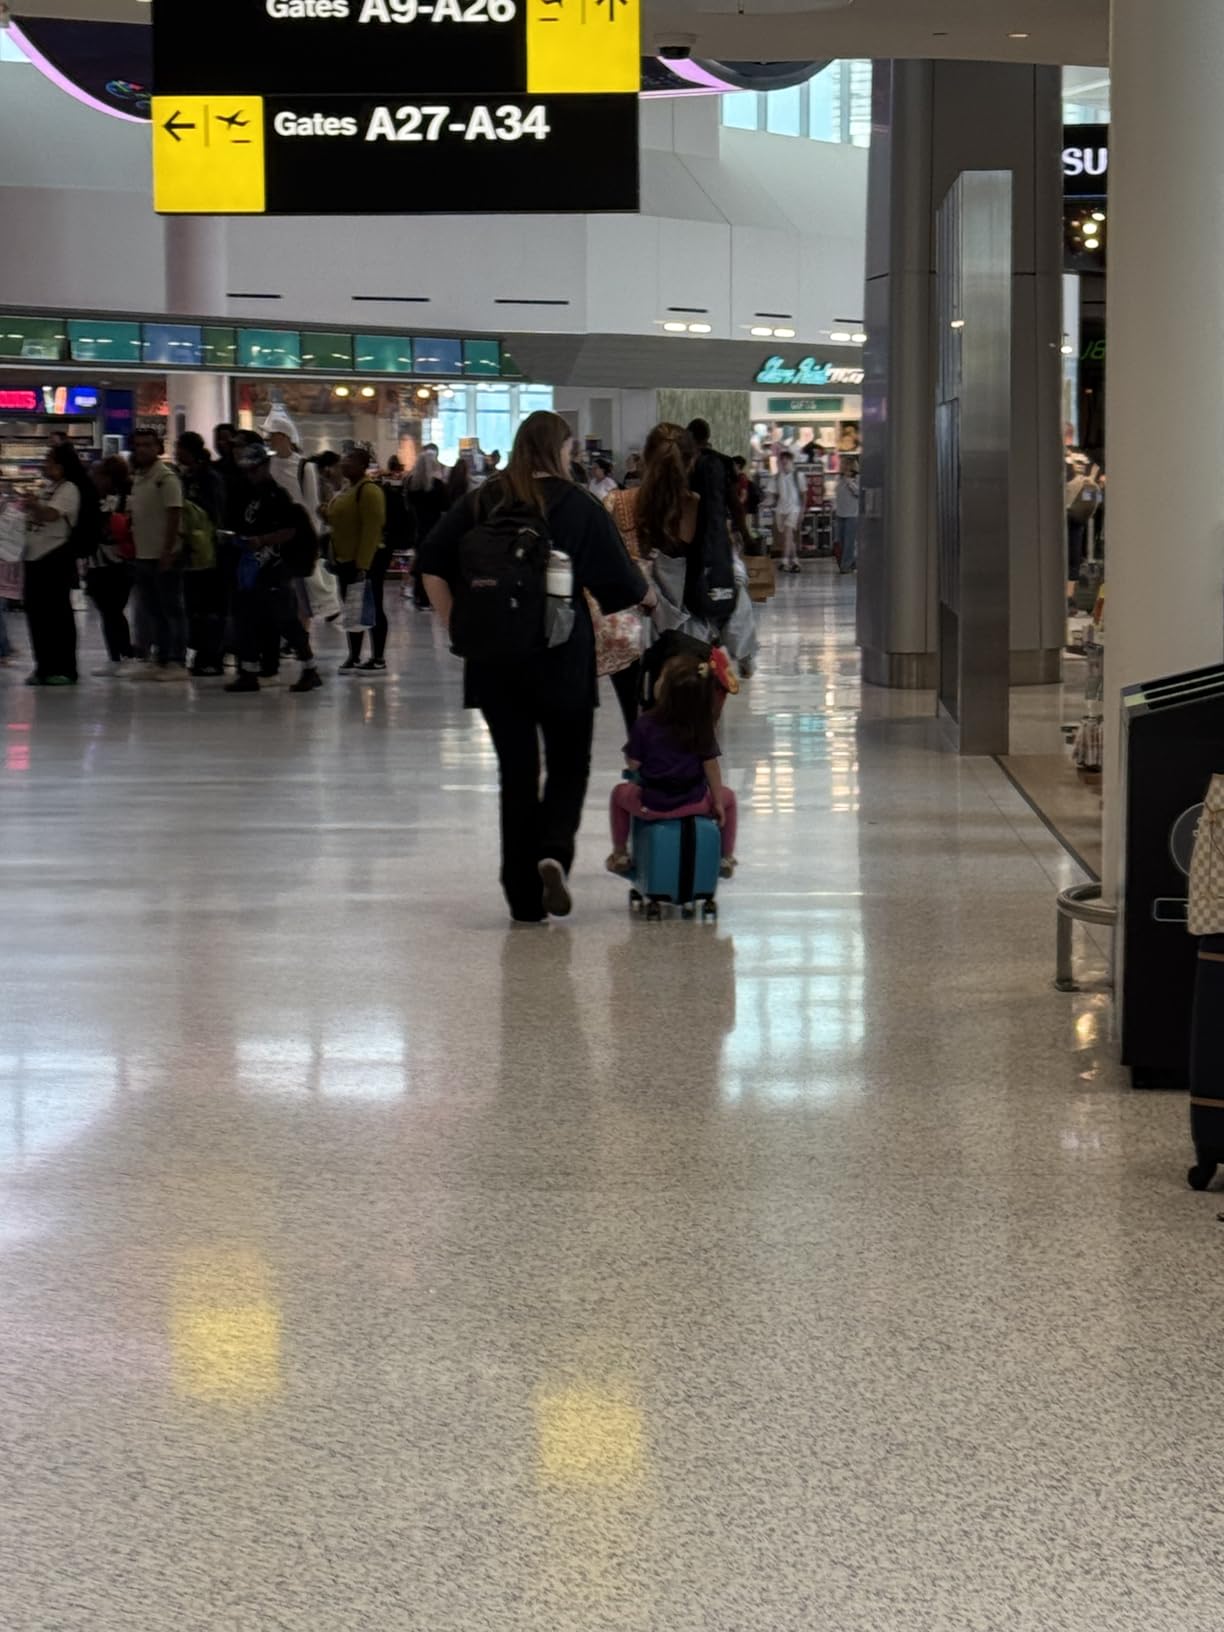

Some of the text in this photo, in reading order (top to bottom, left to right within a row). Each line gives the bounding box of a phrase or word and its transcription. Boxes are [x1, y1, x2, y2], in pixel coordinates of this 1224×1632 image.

[266, 0, 516, 23] Gates A9-A26
[273, 105, 550, 141] Gates A27-A34
